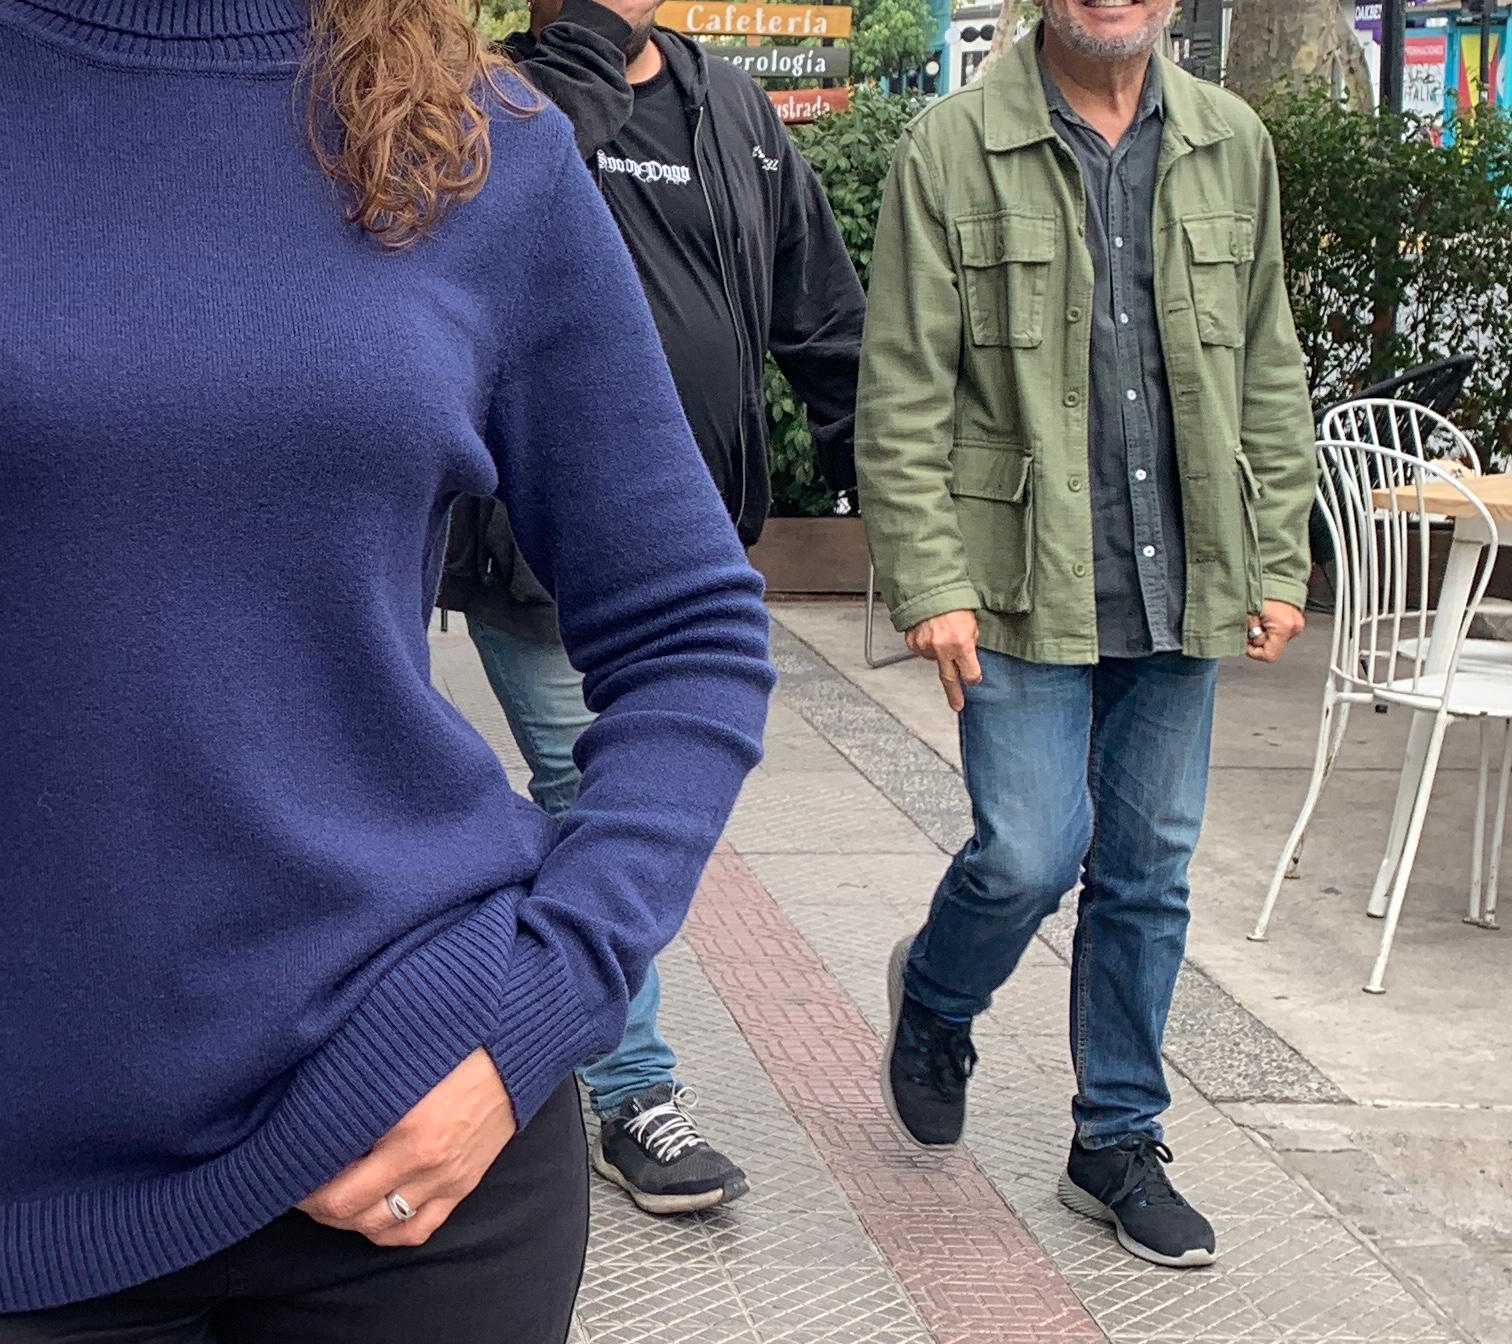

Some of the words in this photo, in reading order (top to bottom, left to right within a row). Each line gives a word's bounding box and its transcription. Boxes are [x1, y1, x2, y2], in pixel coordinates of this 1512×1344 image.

[686, 4, 828, 34] Cafetería
[722, 49, 826, 77] erología
[770, 96, 830, 119] ustrada
